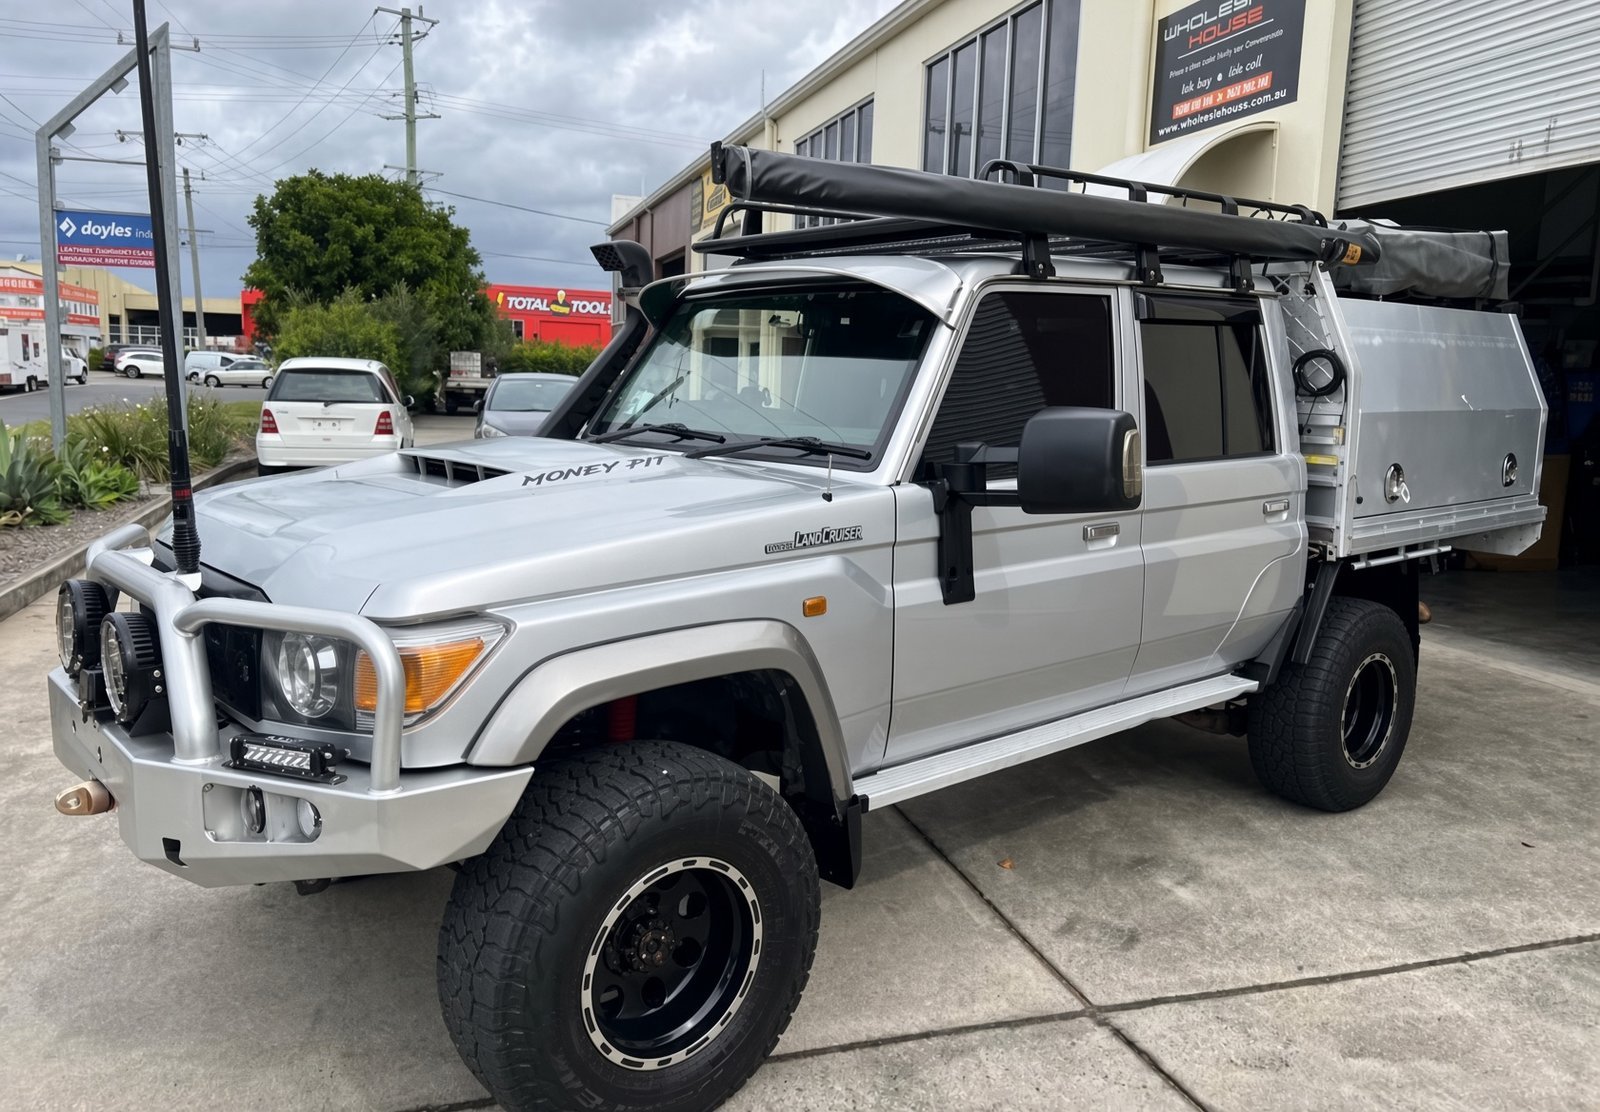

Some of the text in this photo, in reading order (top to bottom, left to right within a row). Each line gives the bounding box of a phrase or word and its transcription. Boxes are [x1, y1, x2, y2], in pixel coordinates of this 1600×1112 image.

[1164, 0, 1252, 41] WHOLES
[1188, 6, 1263, 49] HOUSE
[81, 220, 132, 239] doyles
[507, 296, 550, 311] TOTAL
[521, 454, 669, 486] MONEY PIT
